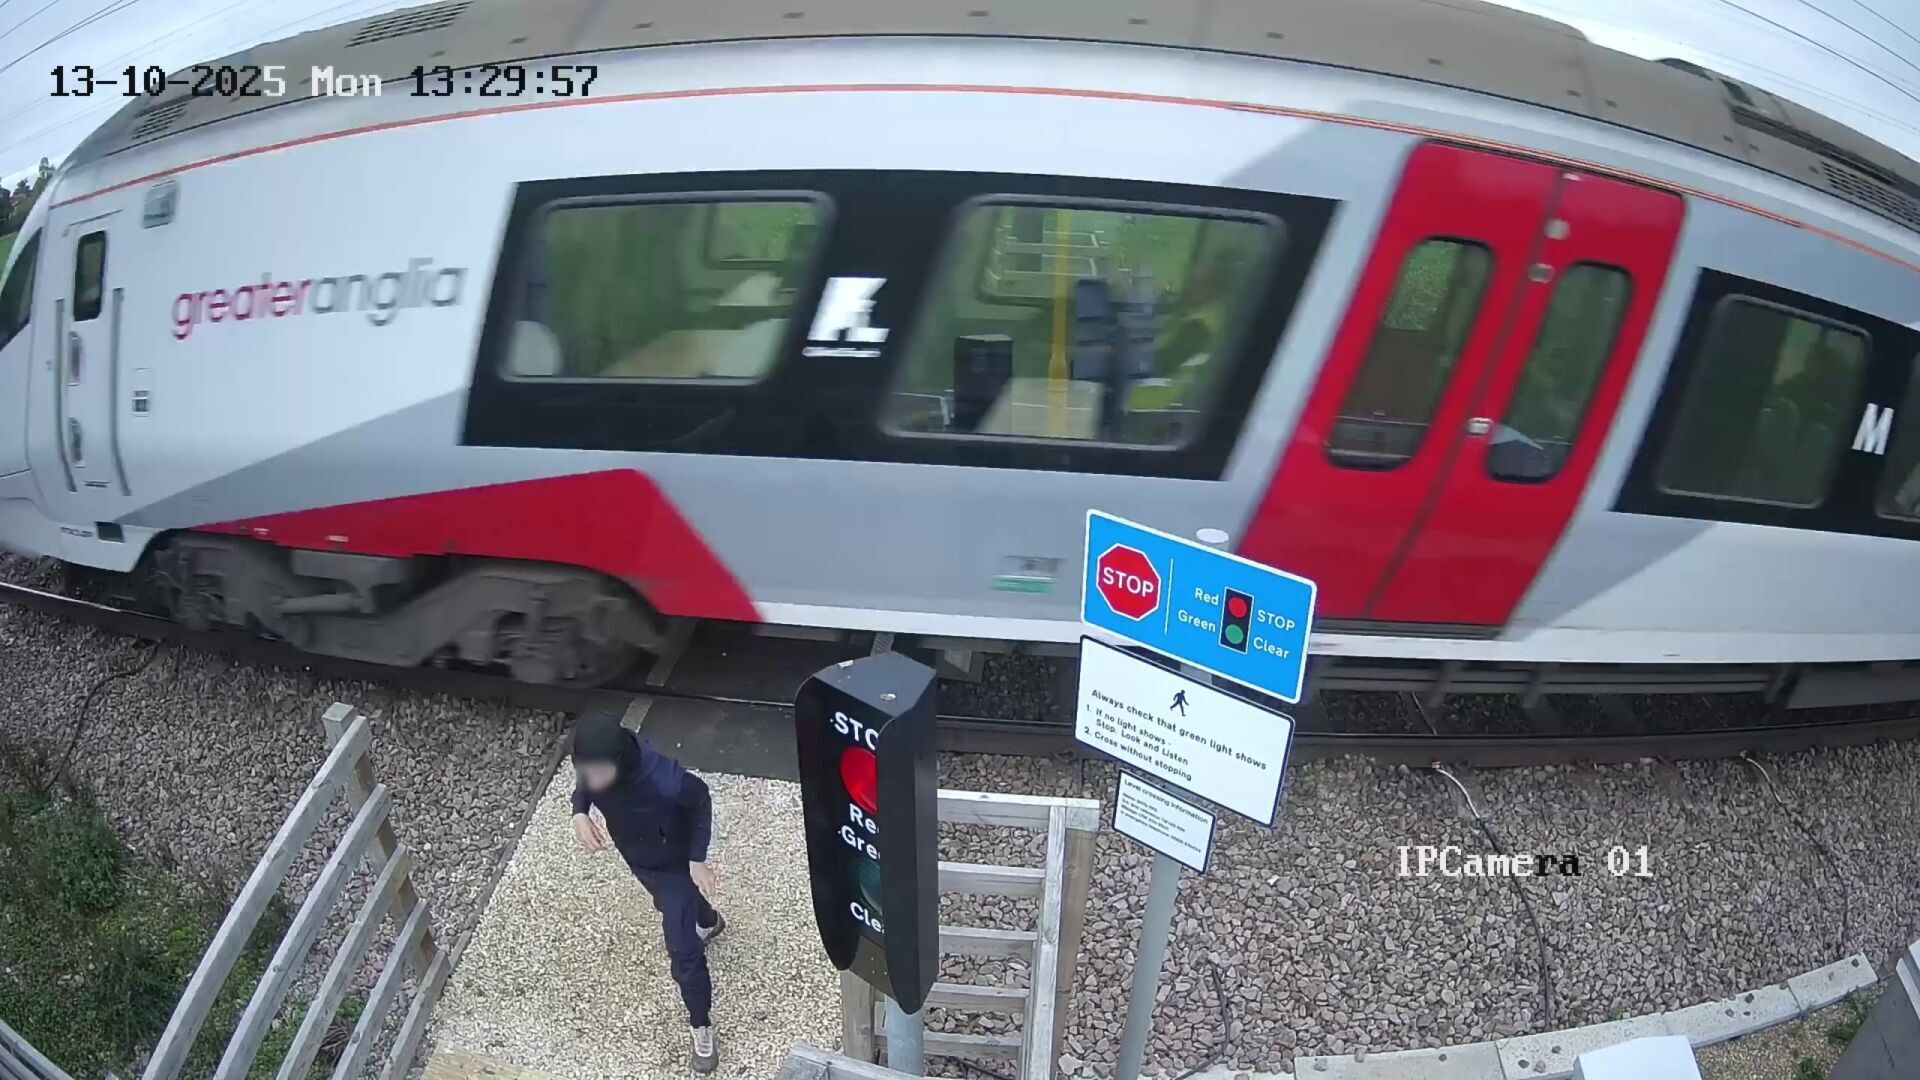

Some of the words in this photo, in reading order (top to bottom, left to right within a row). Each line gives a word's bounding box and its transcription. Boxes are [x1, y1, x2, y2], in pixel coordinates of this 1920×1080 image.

[1102, 567, 1154, 598] STOP
[1194, 587, 1219, 606] Red
[1257, 609, 1296, 632] STOP
[1177, 608, 1216, 633] Green
[1253, 636, 1290, 660] Clear
[834, 711, 879, 751] STO
[1092, 689, 1124, 709] Always
[1126, 705, 1154, 722] check
[1157, 717, 1177, 733] that
[1179, 728, 1207, 745] green
[1210, 739, 1232, 756] light
[1235, 752, 1267, 770] shows
[1096, 708, 1103, 716] If
[1104, 713, 1115, 723] no
[1117, 717, 1137, 733] light
[1139, 729, 1166, 745] shows
[1094, 731, 1118, 748] Cross
[1120, 743, 1153, 763] without
[1154, 760, 1192, 782] stopping
[1121, 729, 1142, 744] Look
[1143, 741, 1159, 753] and
[1162, 748, 1189, 766] Listen
[1124, 779, 1142, 792] Level
[849, 802, 879, 835] Re
[841, 825, 881, 861] Gre
[850, 901, 885, 934] Cle
